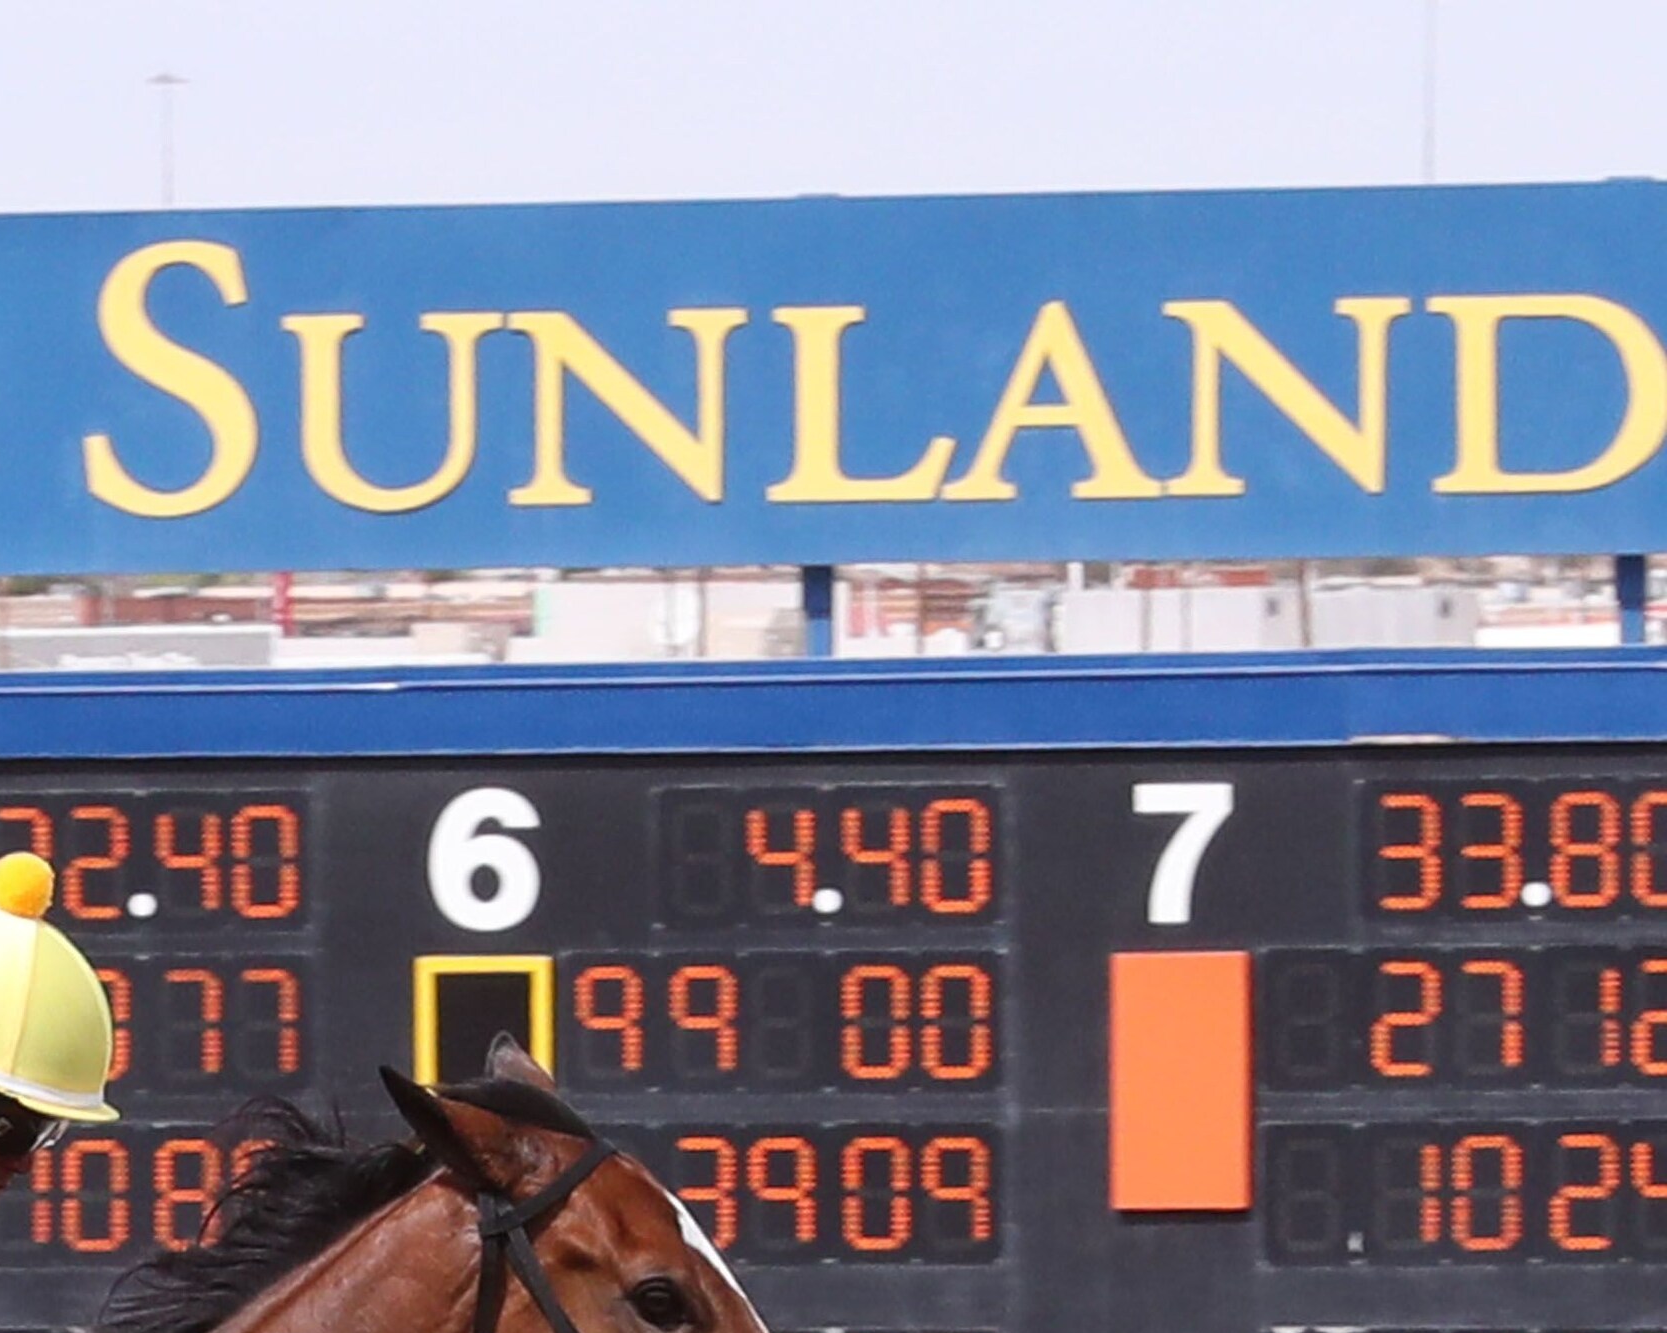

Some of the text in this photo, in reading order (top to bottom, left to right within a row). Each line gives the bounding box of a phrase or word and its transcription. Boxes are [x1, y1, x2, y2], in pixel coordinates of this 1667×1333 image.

[86, 240, 1667, 517] SUNLAND
[427, 787, 541, 932] 6
[745, 798, 993, 914] 4.40
[1132, 782, 1234, 924] 7
